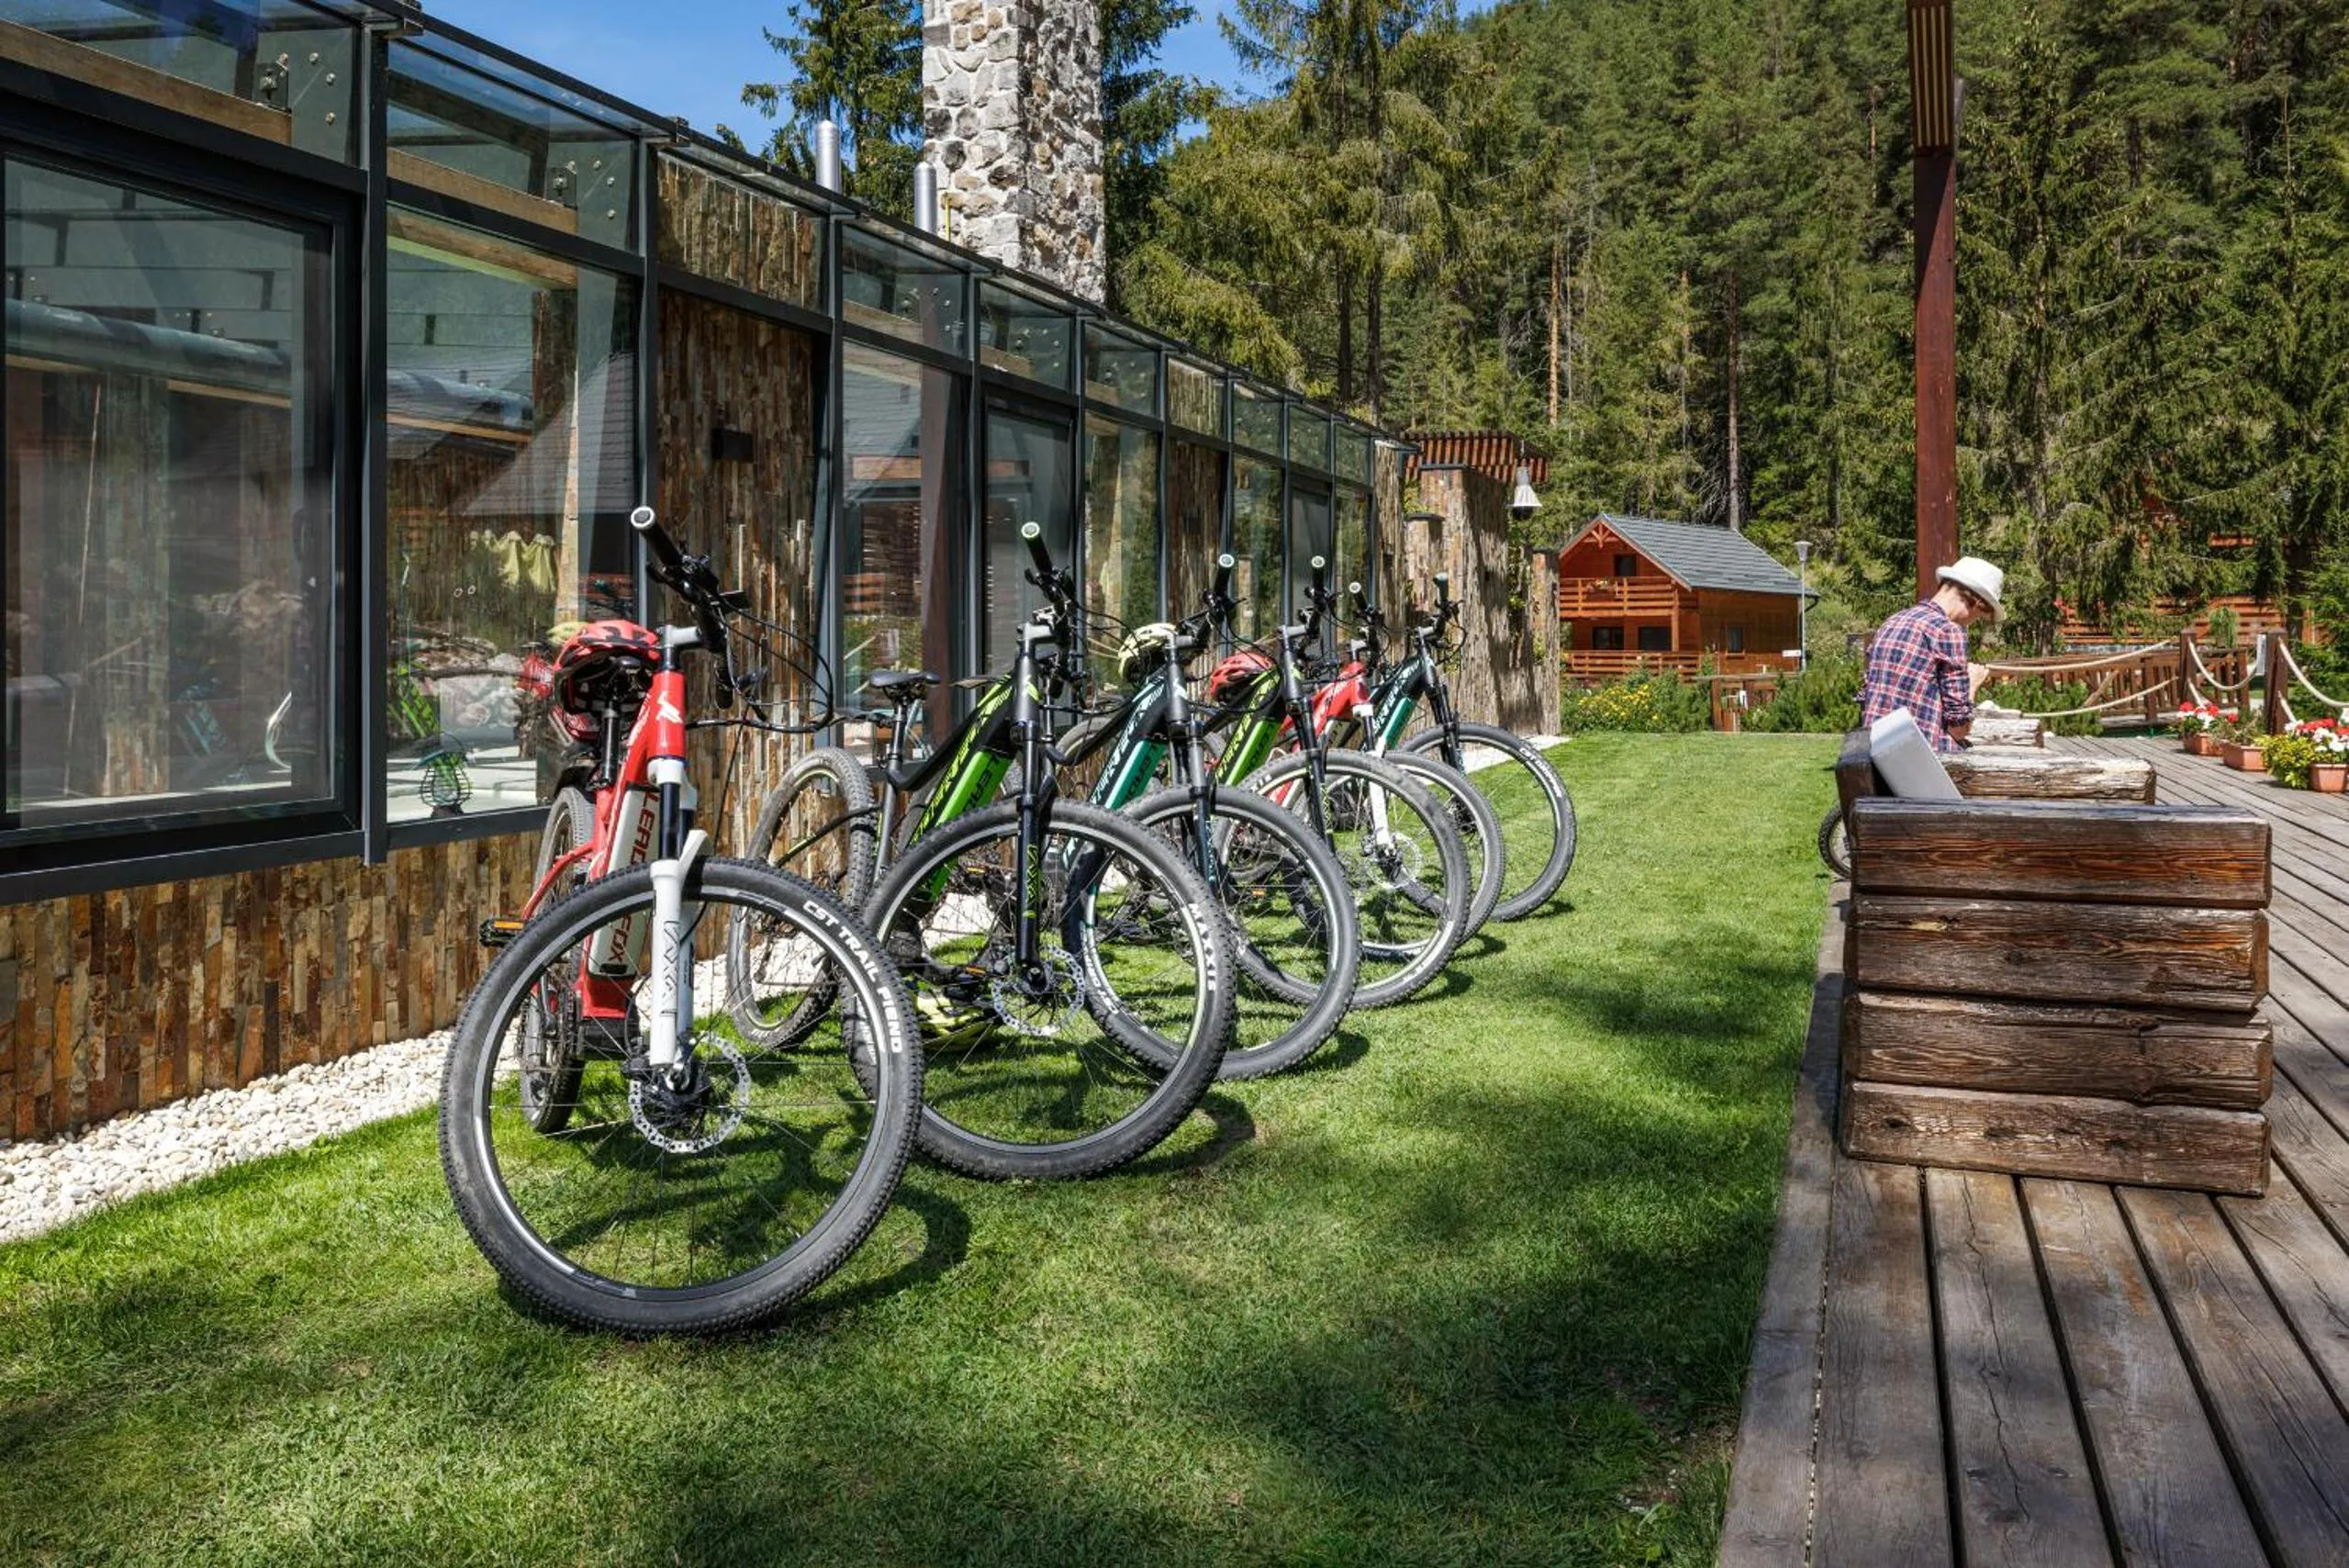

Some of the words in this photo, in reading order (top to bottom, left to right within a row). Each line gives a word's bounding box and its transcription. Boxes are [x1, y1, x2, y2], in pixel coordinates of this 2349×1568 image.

[630, 790, 661, 866] LEAD
[608, 915, 632, 962] FOX
[802, 900, 840, 927] CST
[839, 925, 880, 982] TRAIL
[877, 986, 903, 1053] FIEND
[1188, 902, 1217, 991] MAXXIS
